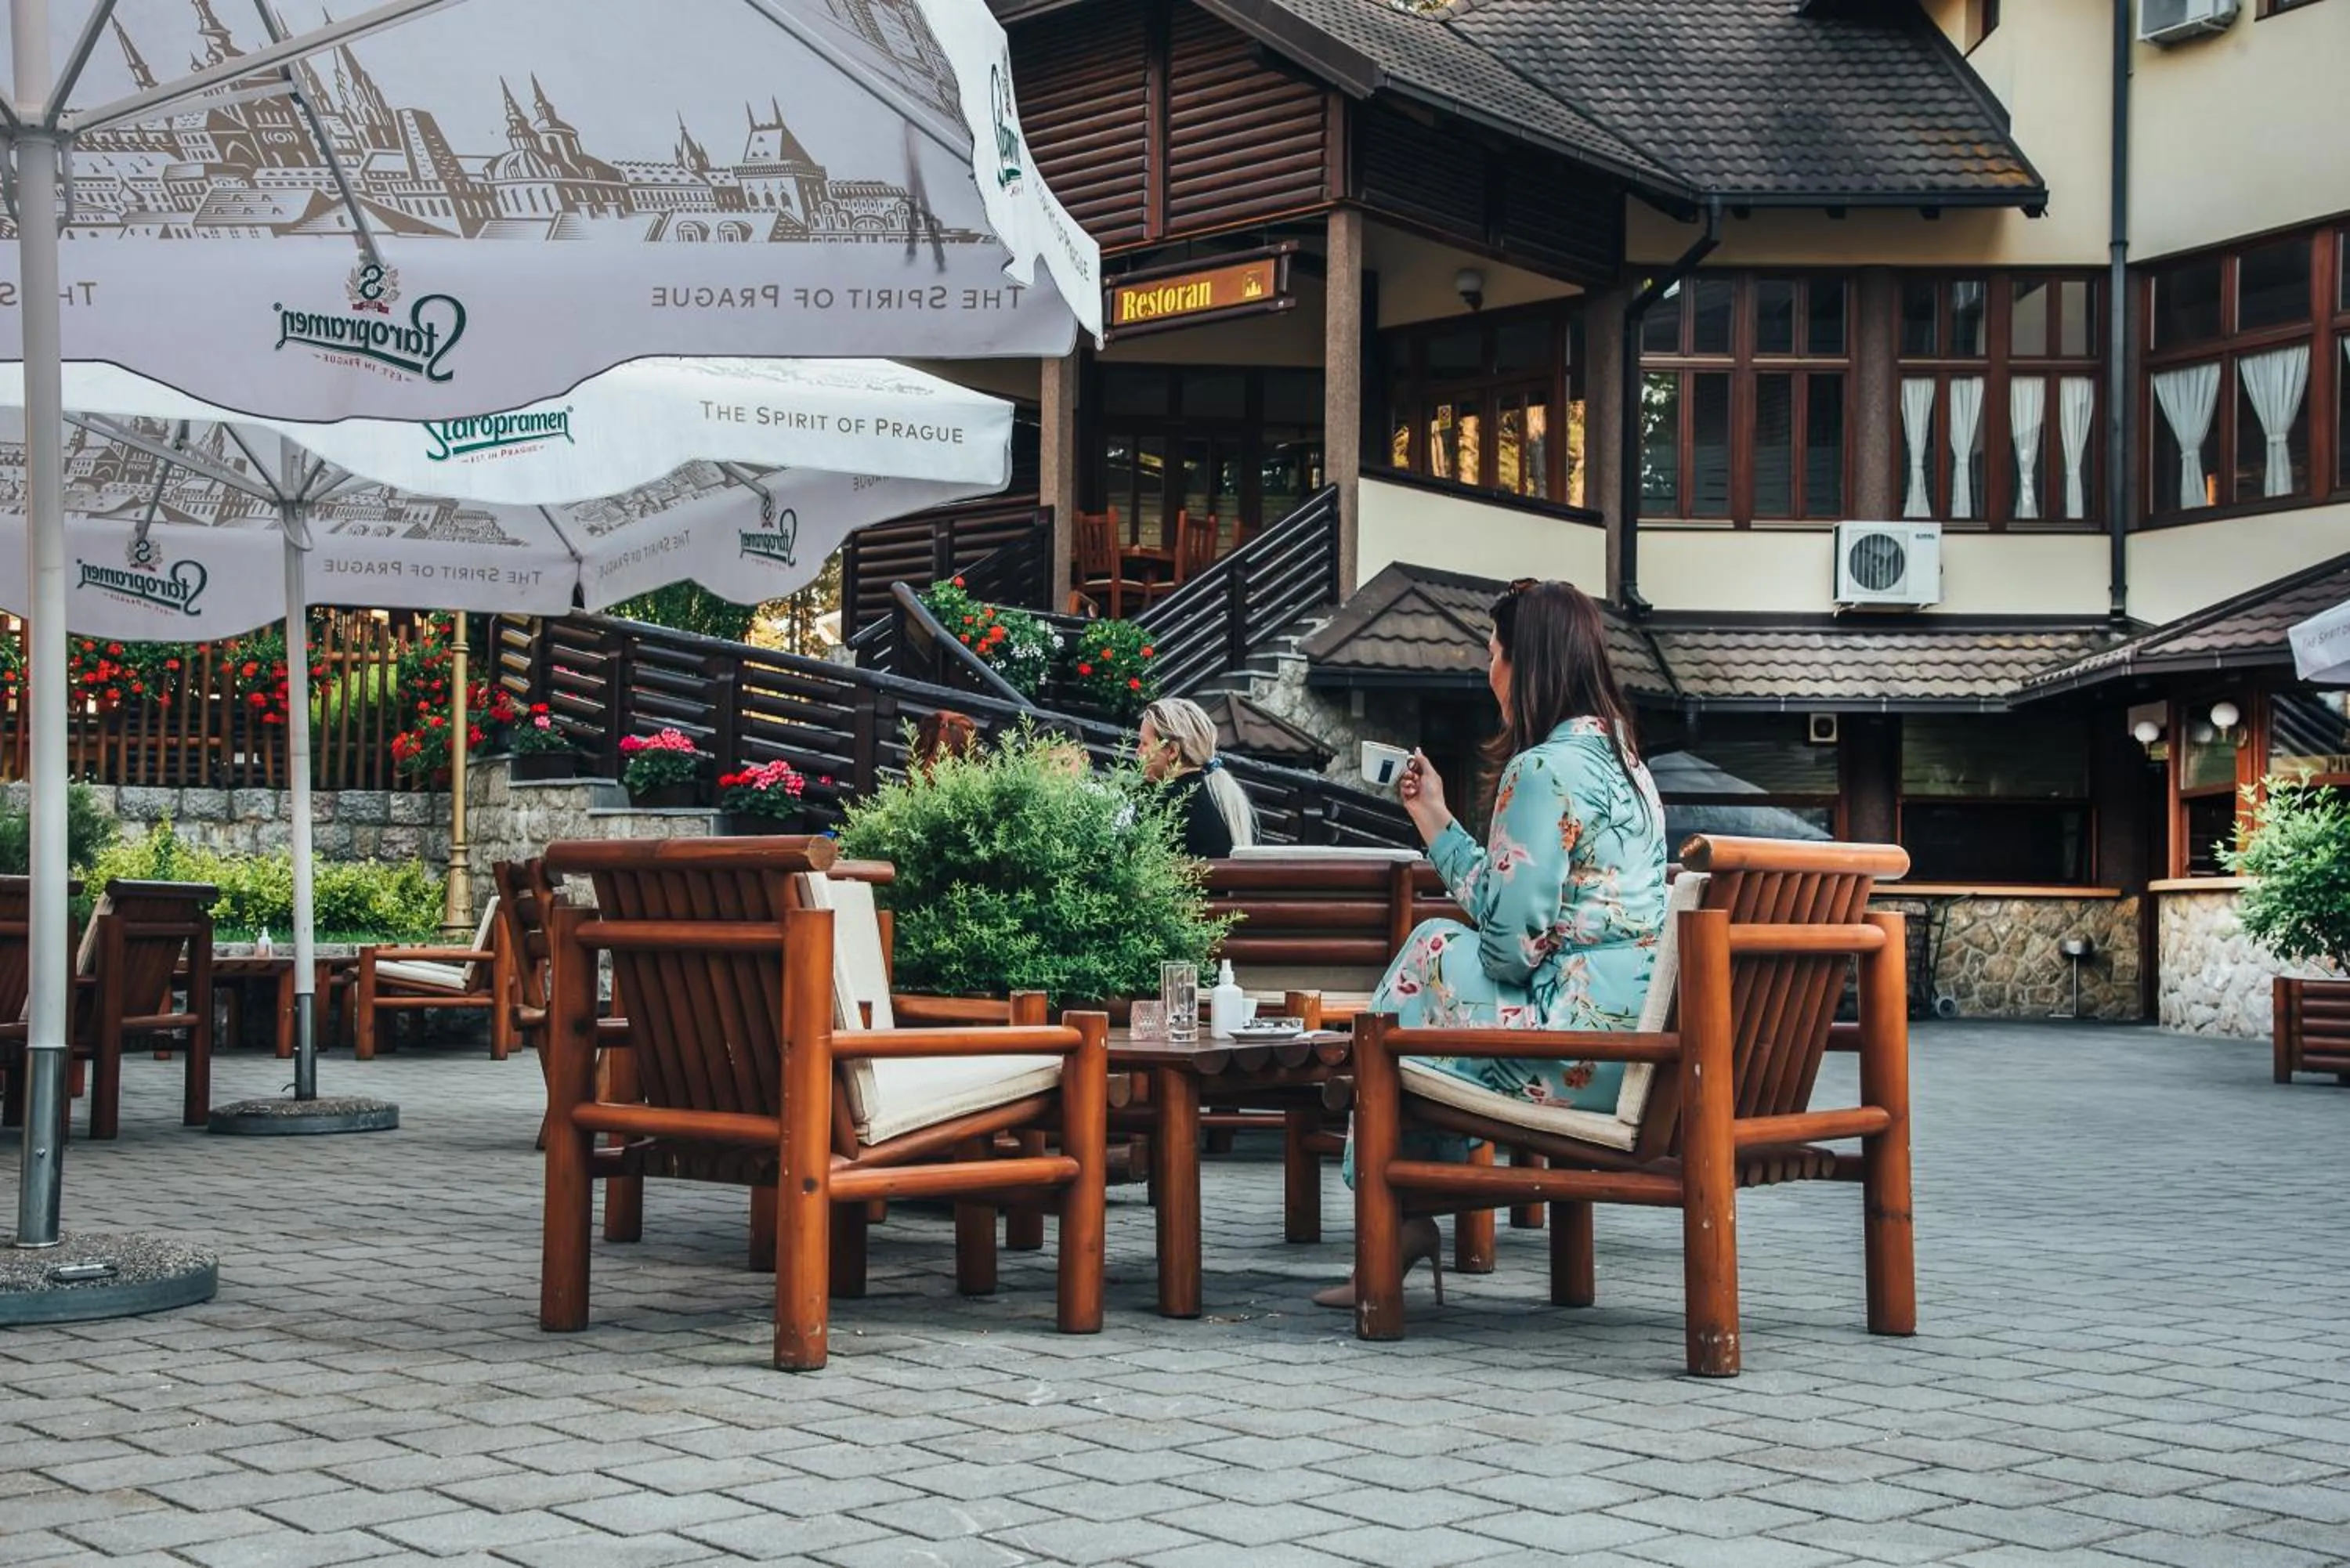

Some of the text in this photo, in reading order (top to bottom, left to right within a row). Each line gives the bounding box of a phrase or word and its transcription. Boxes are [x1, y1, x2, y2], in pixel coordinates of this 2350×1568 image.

[1122, 281, 1212, 320] Restoran
[700, 400, 964, 444] THE SPIRIT OF PRAGUE
